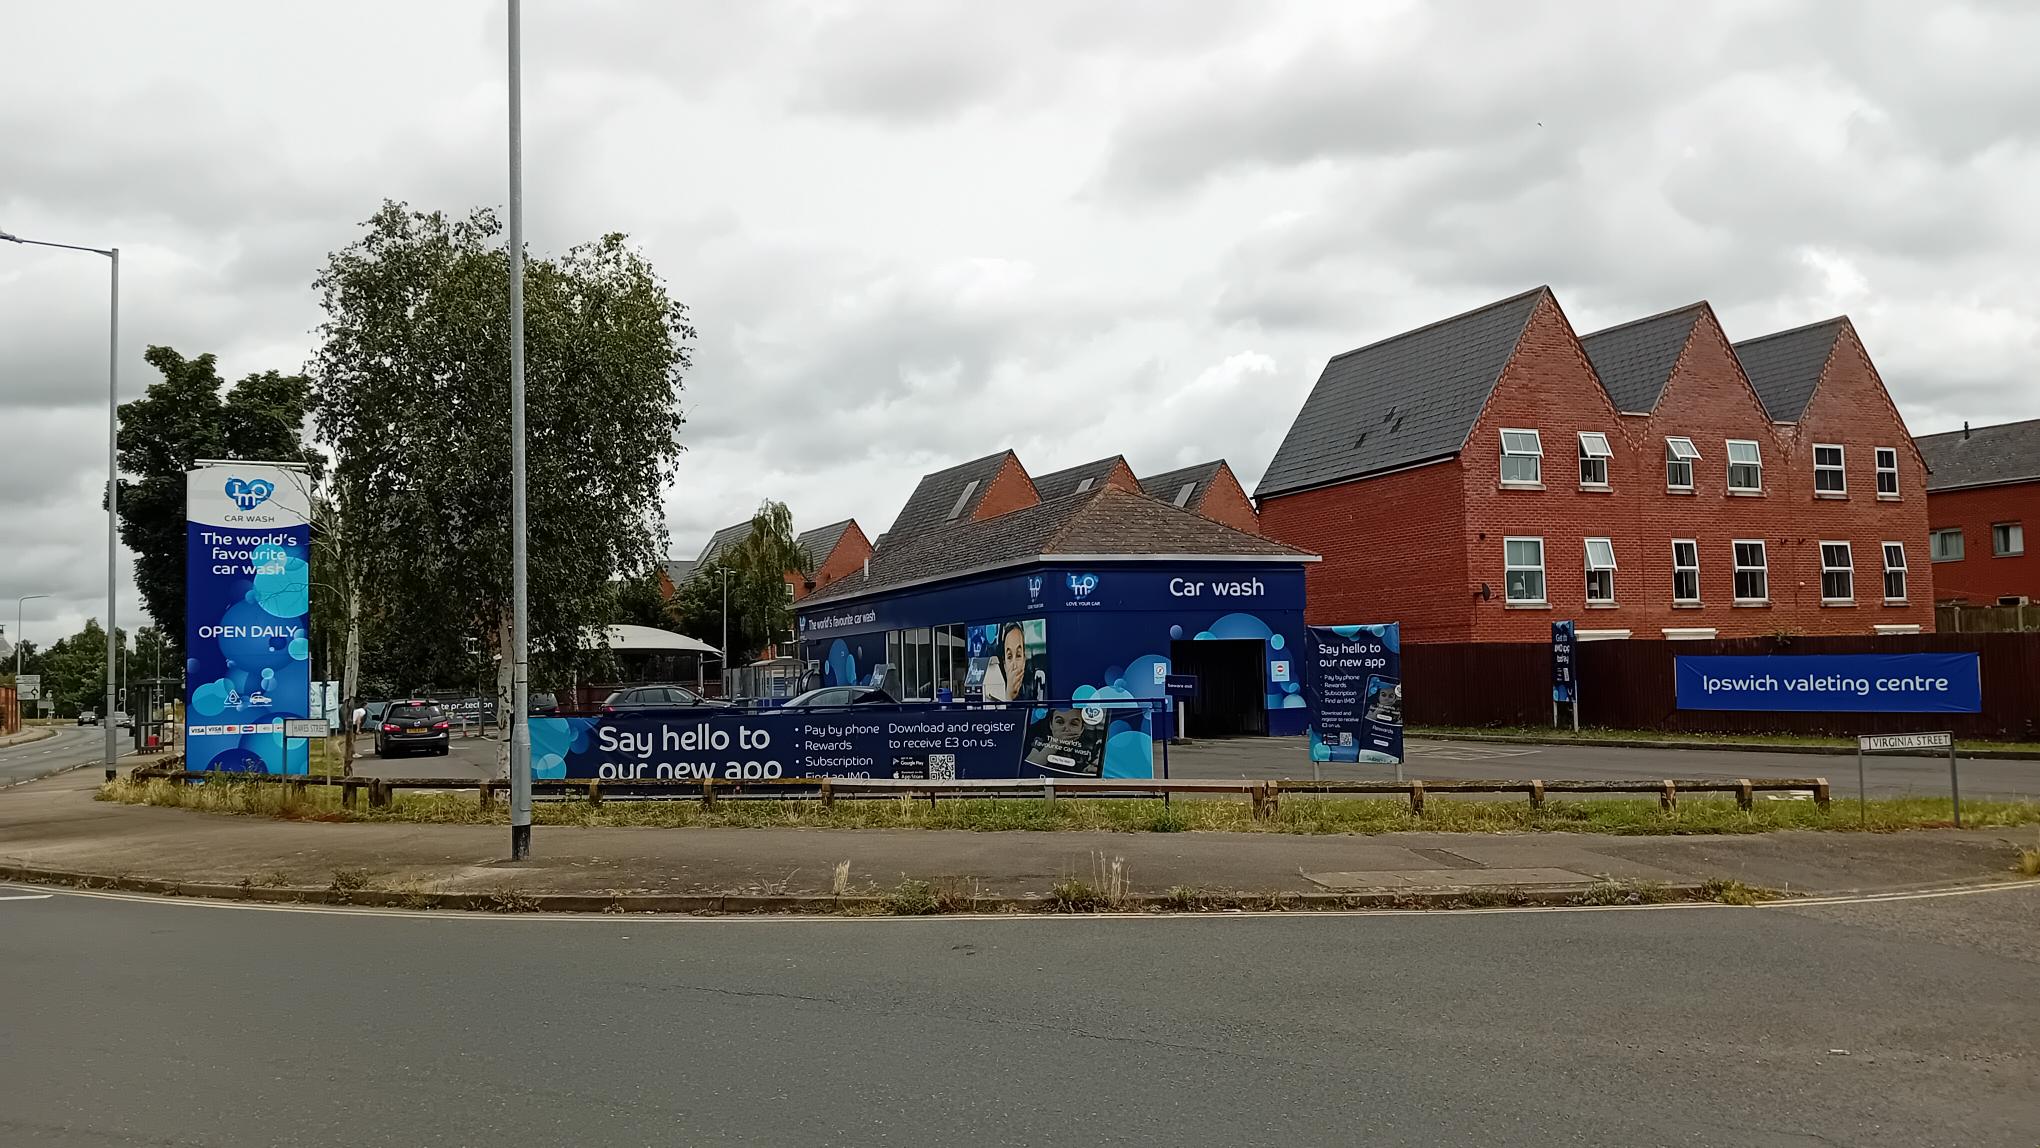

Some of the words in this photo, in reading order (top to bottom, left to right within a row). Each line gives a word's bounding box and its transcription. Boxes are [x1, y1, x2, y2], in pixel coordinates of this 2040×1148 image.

[200, 532, 232, 545] The
[212, 547, 286, 560] favourite
[212, 565, 238, 575] car
[242, 563, 285, 575] wash
[1169, 578, 1204, 596] Car
[1212, 577, 1264, 596] wash
[833, 613, 853, 627] favourite
[863, 609, 876, 622] wash
[198, 626, 246, 638] OPEN
[251, 626, 297, 638] DAILY
[1319, 644, 1339, 656] Say
[1341, 643, 1367, 654] hello
[1370, 643, 1381, 653] to
[1365, 658, 1386, 669] app
[1703, 674, 1778, 694] Ipswich
[1784, 674, 1870, 696] valeting
[1875, 675, 1948, 691] centre
[804, 724, 825, 737] Pay
[828, 724, 842, 737] by
[845, 724, 880, 736] phone
[888, 722, 944, 733] Download
[947, 722, 969, 732] and
[971, 721, 1016, 735] register
[599, 726, 652, 758] Say
[663, 723, 730, 751] hello
[739, 725, 770, 749] to
[805, 740, 852, 750] Rewards
[888, 739, 900, 749] to
[903, 738, 942, 748] receive
[962, 739, 977, 748] on
[980, 738, 997, 747] us.
[1035, 739, 1062, 750] favourite
[1873, 737, 1914, 747] VIRGINIA
[1916, 735, 1949, 745] STREET
[805, 756, 873, 768] Subscription
[599, 762, 648, 779] our
[656, 762, 716, 779] new
